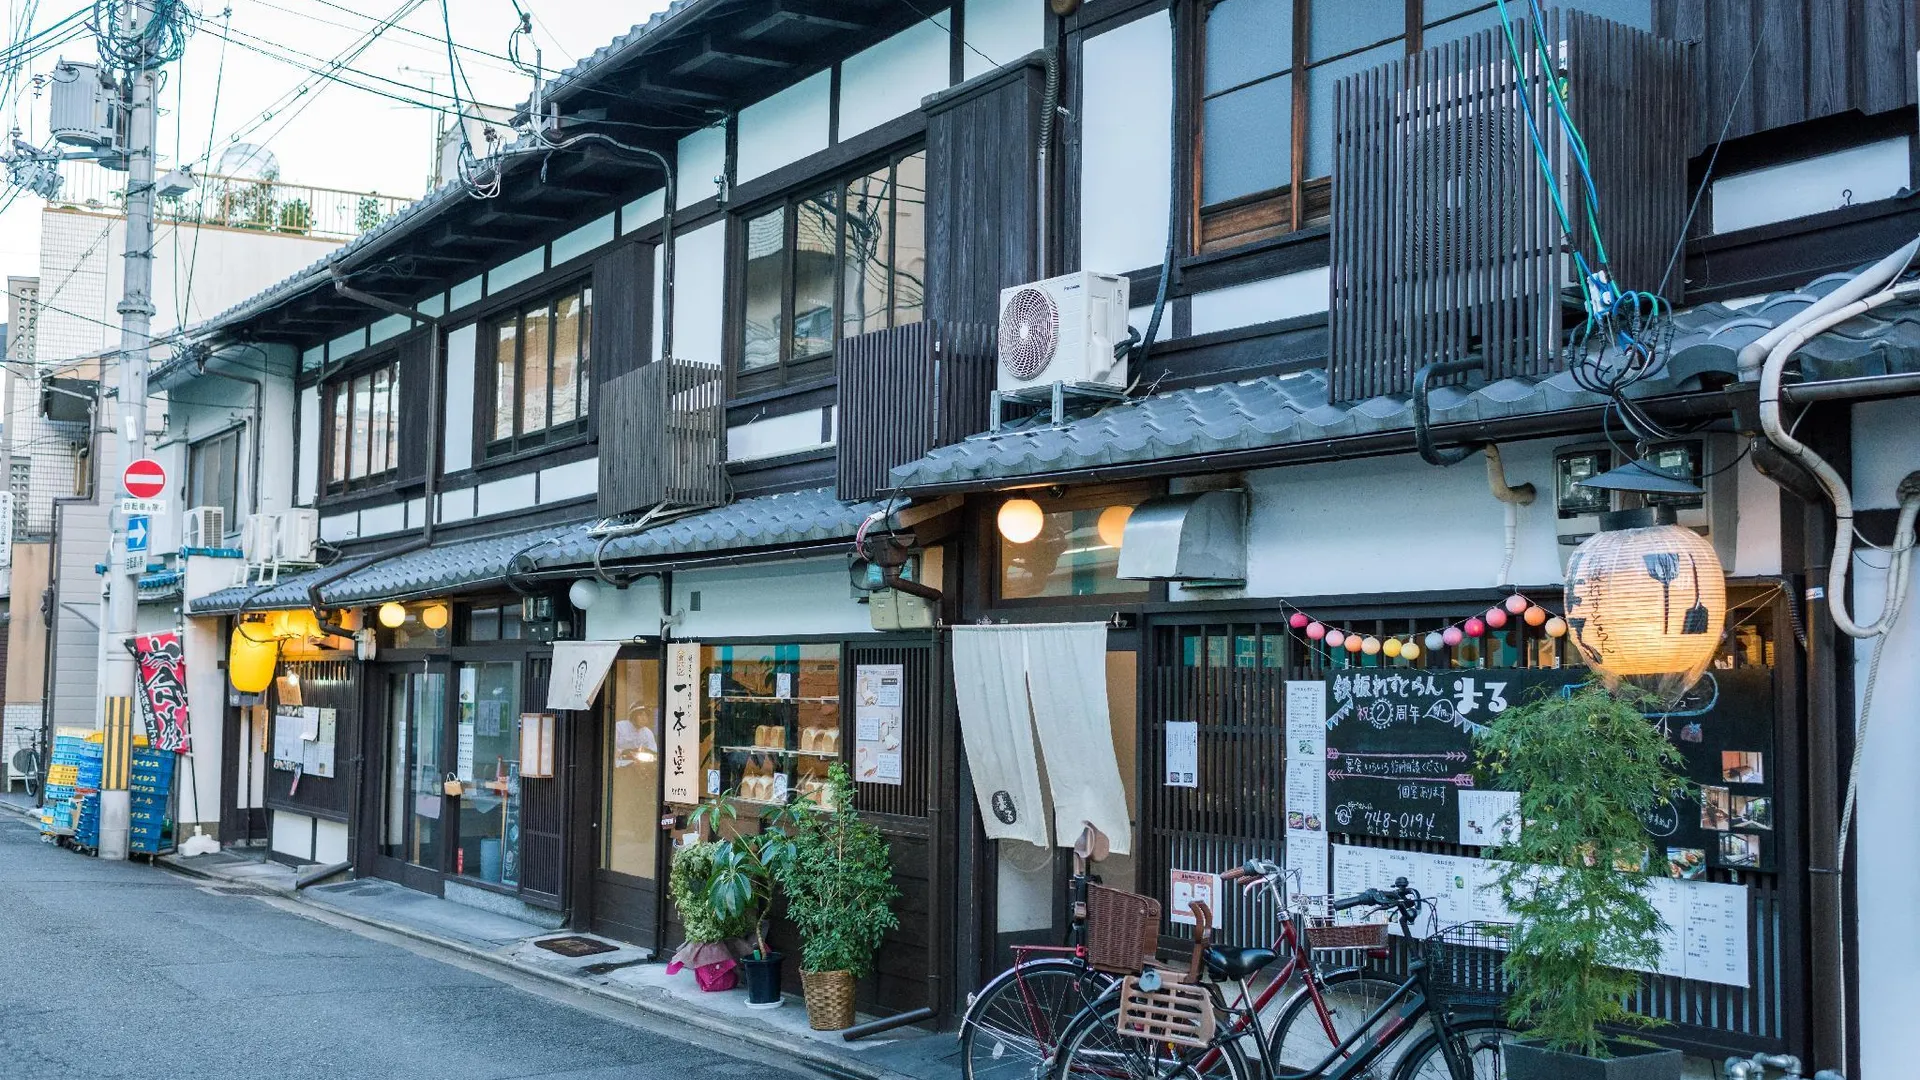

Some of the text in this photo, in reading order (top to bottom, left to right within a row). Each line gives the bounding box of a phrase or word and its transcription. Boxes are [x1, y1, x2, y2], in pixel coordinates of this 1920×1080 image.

[124, 502, 164, 511] 自転車を除く
[1454, 677, 1508, 715] まる
[673, 684, 687, 775] 一本堂
[1397, 782, 1447, 806] 個室あります
[1364, 810, 1436, 829] 748-0194
